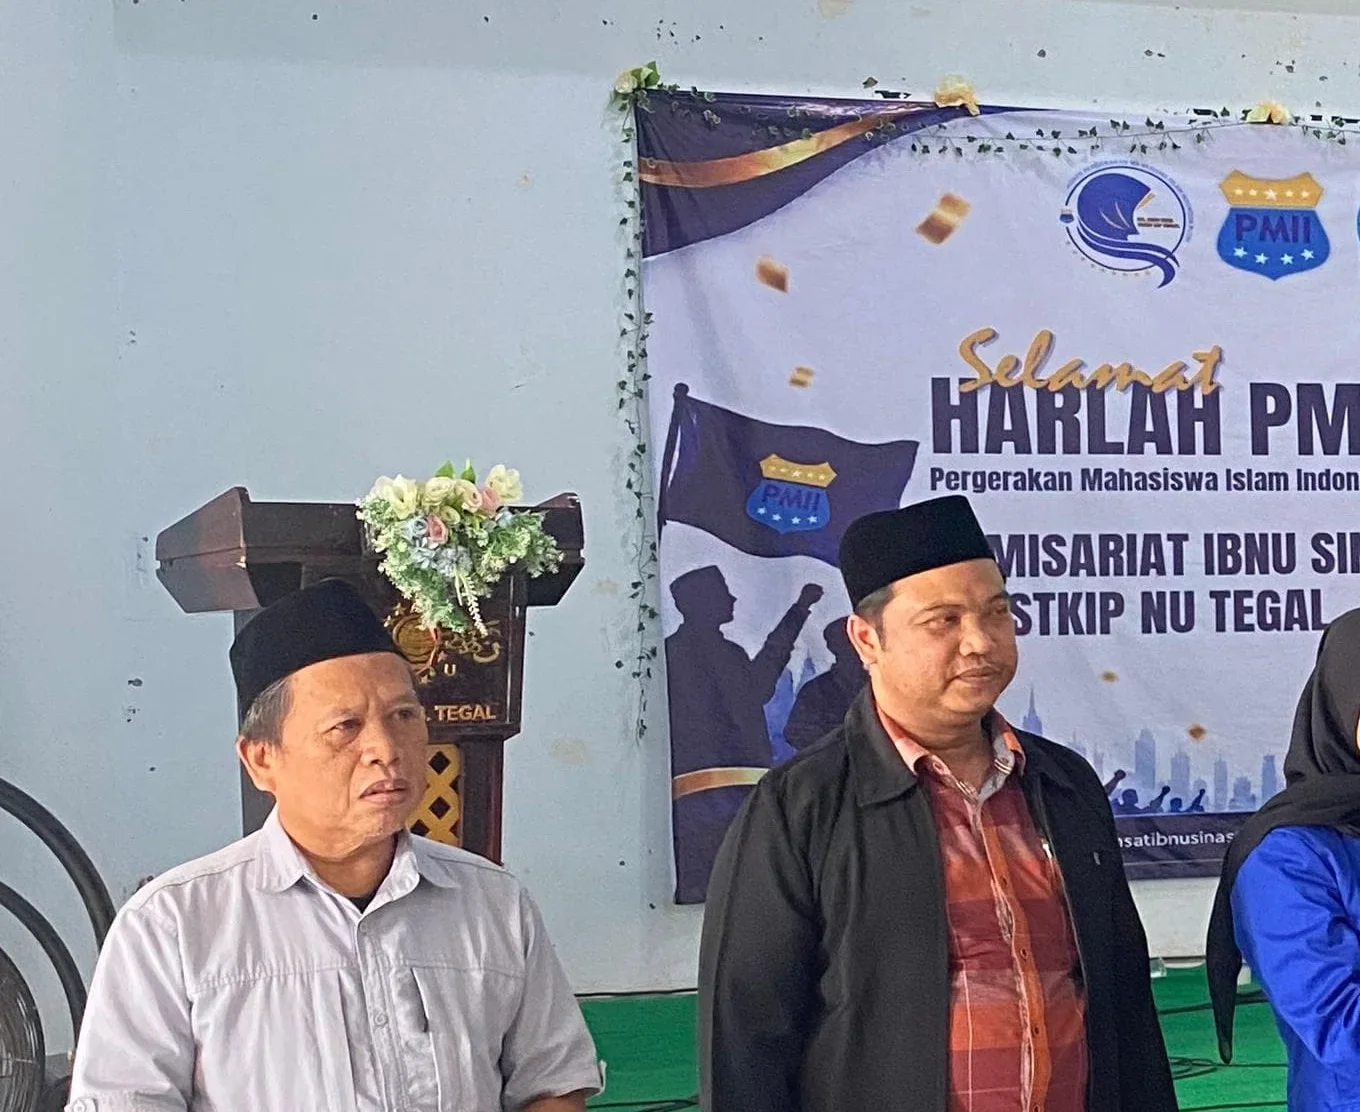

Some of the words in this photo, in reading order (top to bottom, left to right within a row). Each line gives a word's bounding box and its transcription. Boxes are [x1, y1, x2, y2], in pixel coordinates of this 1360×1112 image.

[1235, 213, 1311, 244] PMII
[957, 326, 1223, 395] Selamat
[930, 376, 1222, 456] HARLAH
[762, 483, 822, 512] PMII
[929, 466, 1073, 494] Pergerakan
[1080, 467, 1219, 492] Mahasiswa
[1225, 467, 1289, 492] Islam
[985, 532, 1190, 577] MISARIAT
[1203, 531, 1297, 576] IBNU
[1010, 591, 1126, 636] STKIP
[1140, 590, 1195, 635] NU
[1208, 588, 1330, 633] TEGAL
[434, 703, 497, 722] TEGAL
